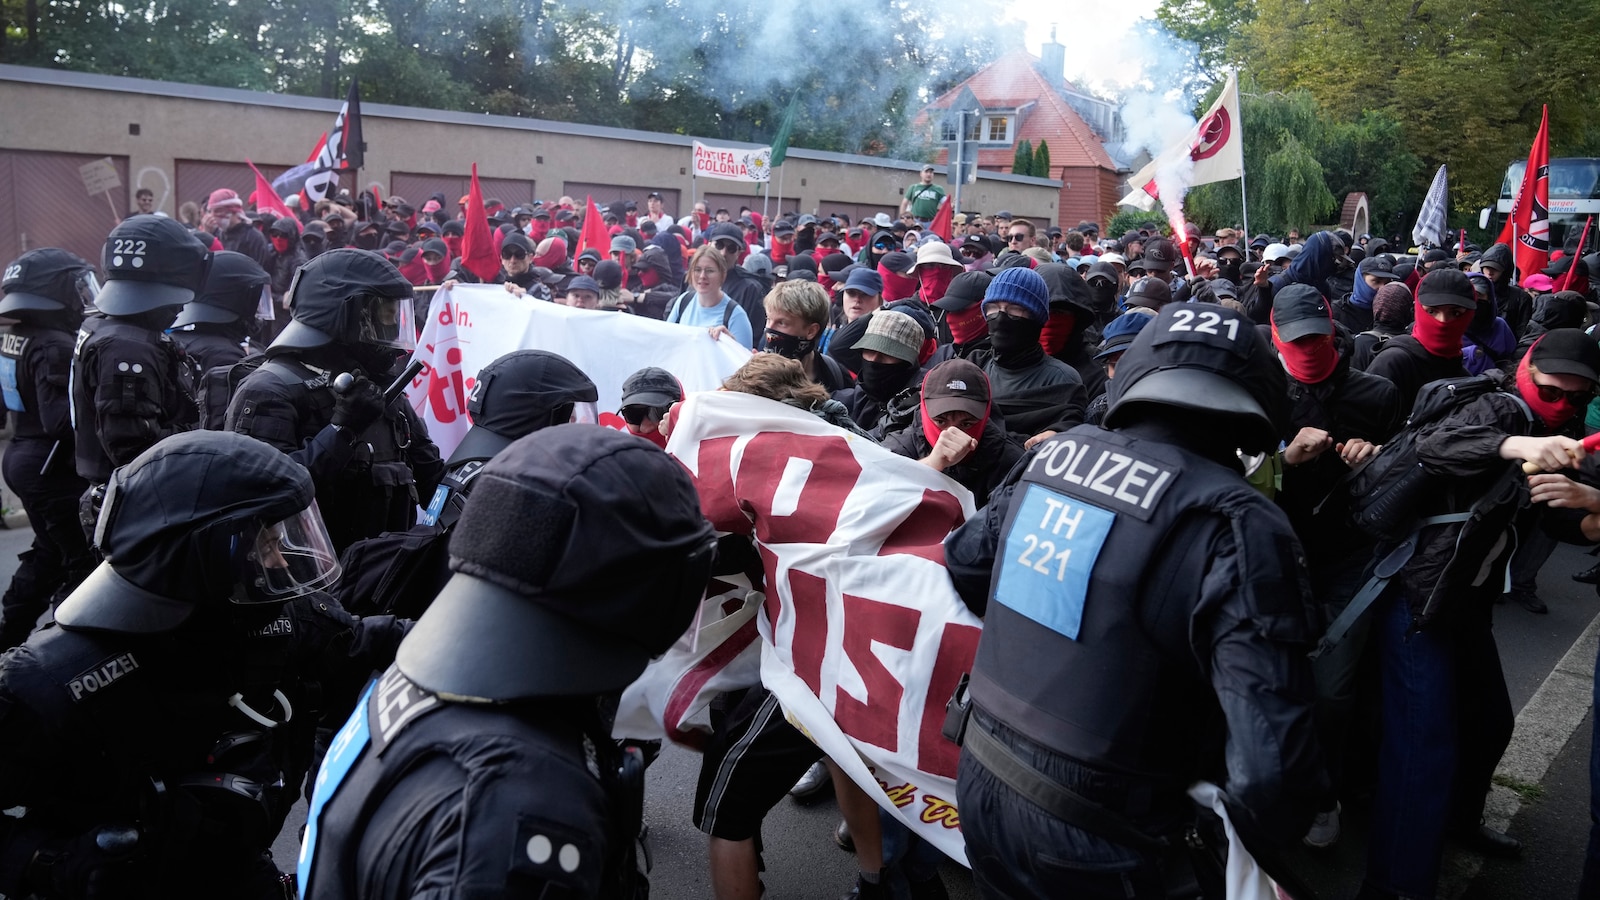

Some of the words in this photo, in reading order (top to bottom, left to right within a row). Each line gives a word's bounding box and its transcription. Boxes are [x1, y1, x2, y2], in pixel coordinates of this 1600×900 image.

[695, 146, 734, 164] ANTIFA
[697, 159, 748, 175] COLONIA
[113, 239, 147, 255] 222
[1521, 233, 1536, 246] ON
[1168, 308, 1240, 342] 221
[1028, 440, 1171, 510] POLIZEI
[1039, 497, 1085, 540] TH
[1017, 533, 1072, 582] 221
[69, 653, 139, 700] POLIZEI
